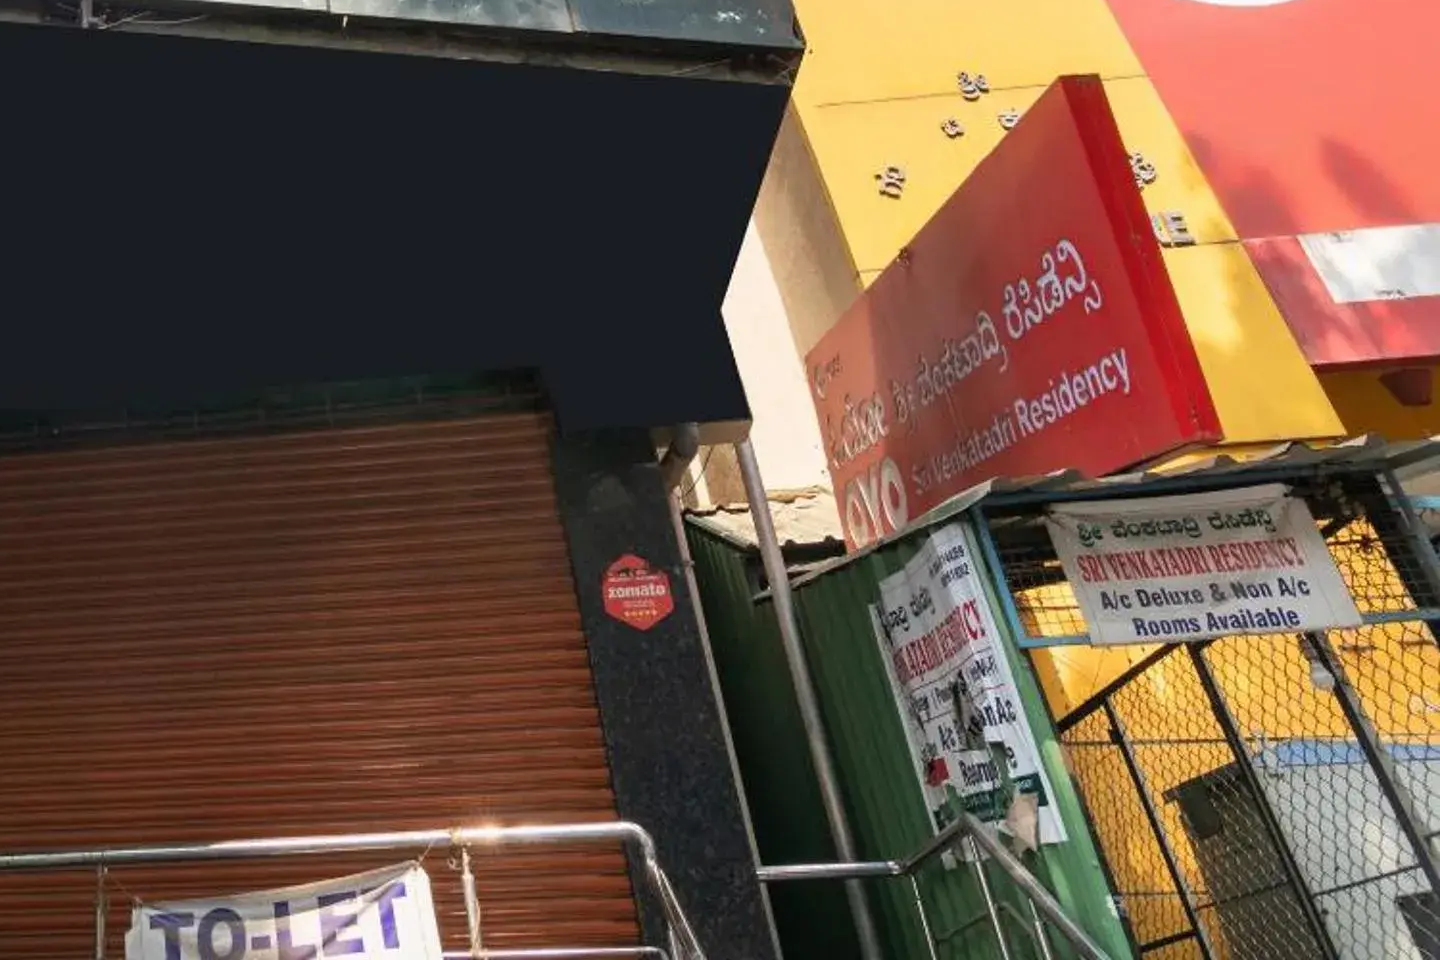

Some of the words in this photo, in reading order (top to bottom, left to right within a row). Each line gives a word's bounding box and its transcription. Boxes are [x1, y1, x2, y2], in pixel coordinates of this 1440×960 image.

[845, 456, 909, 548] OYO
[1015, 347, 1131, 439] Residency
[1076, 549, 1109, 583] SRI
[1106, 542, 1210, 582] VENKATADRI
[1208, 536, 1305, 575] RESIDENCY
[607, 583, 666, 599] zomato
[1100, 590, 1132, 611] A/c
[1135, 583, 1205, 610] Deluxe
[1210, 582, 1228, 602] &
[1230, 580, 1274, 600] Non
[1276, 575, 1311, 599] A/c
[1132, 615, 1201, 637] Rooms
[1207, 606, 1301, 632] Available
[149, 881, 407, 960] TO-LET
